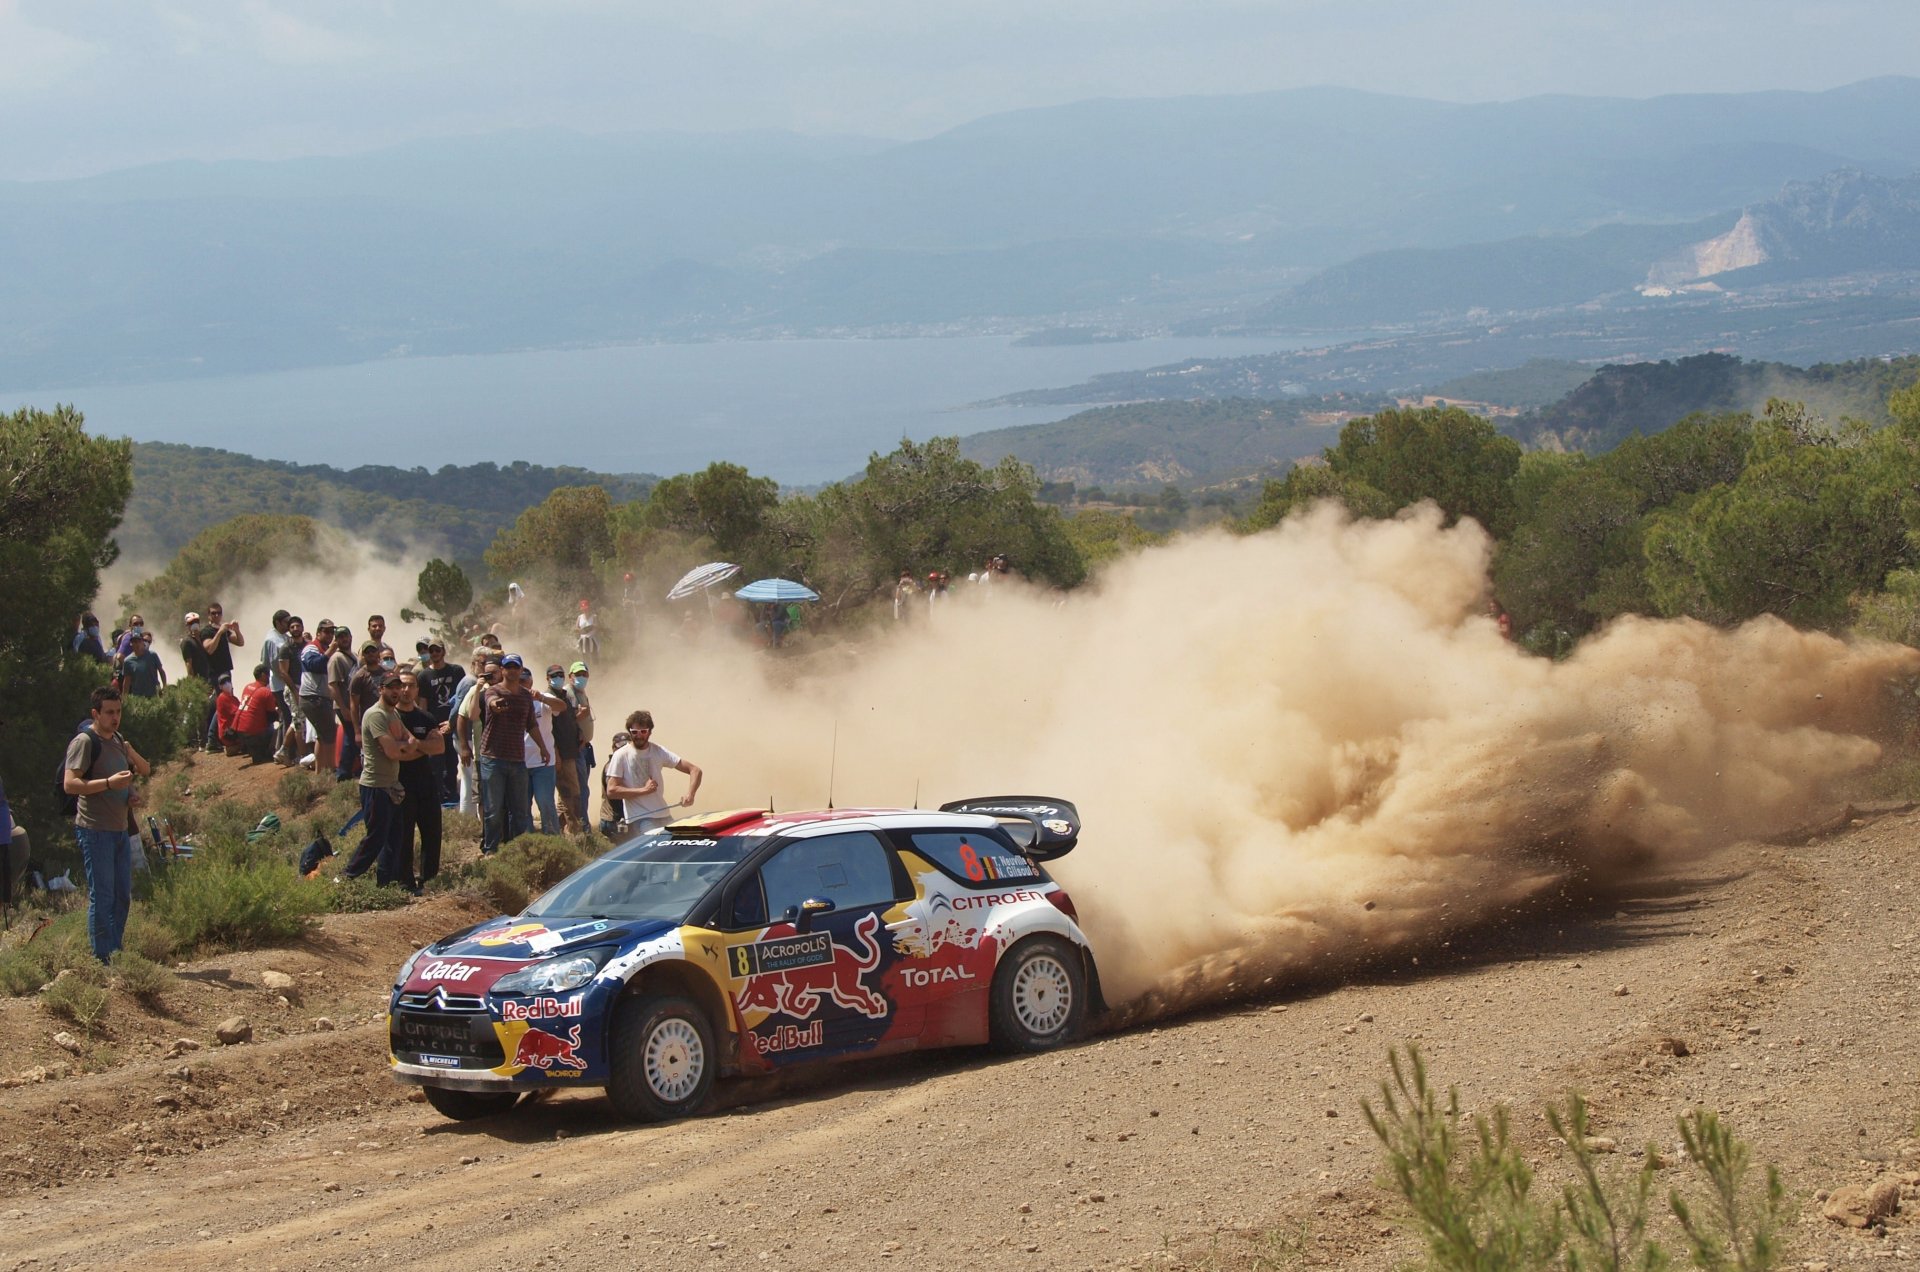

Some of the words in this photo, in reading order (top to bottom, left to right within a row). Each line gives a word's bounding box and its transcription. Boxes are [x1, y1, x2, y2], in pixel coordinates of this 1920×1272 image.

[959, 843, 985, 881] 8
[762, 936, 827, 960] ACROPOLIS
[421, 960, 482, 982] Qatar
[736, 946, 750, 976] 8
[766, 960, 779, 969] THE
[779, 957, 796, 967] RALLY
[796, 956, 807, 964] OF
[806, 953, 824, 963] GODS
[900, 964, 976, 988] TOTAL
[503, 997, 542, 1021] Red
[543, 996, 583, 1019] Bull
[784, 1020, 823, 1050] Bull
[429, 1056, 459, 1066] MICHELIN
